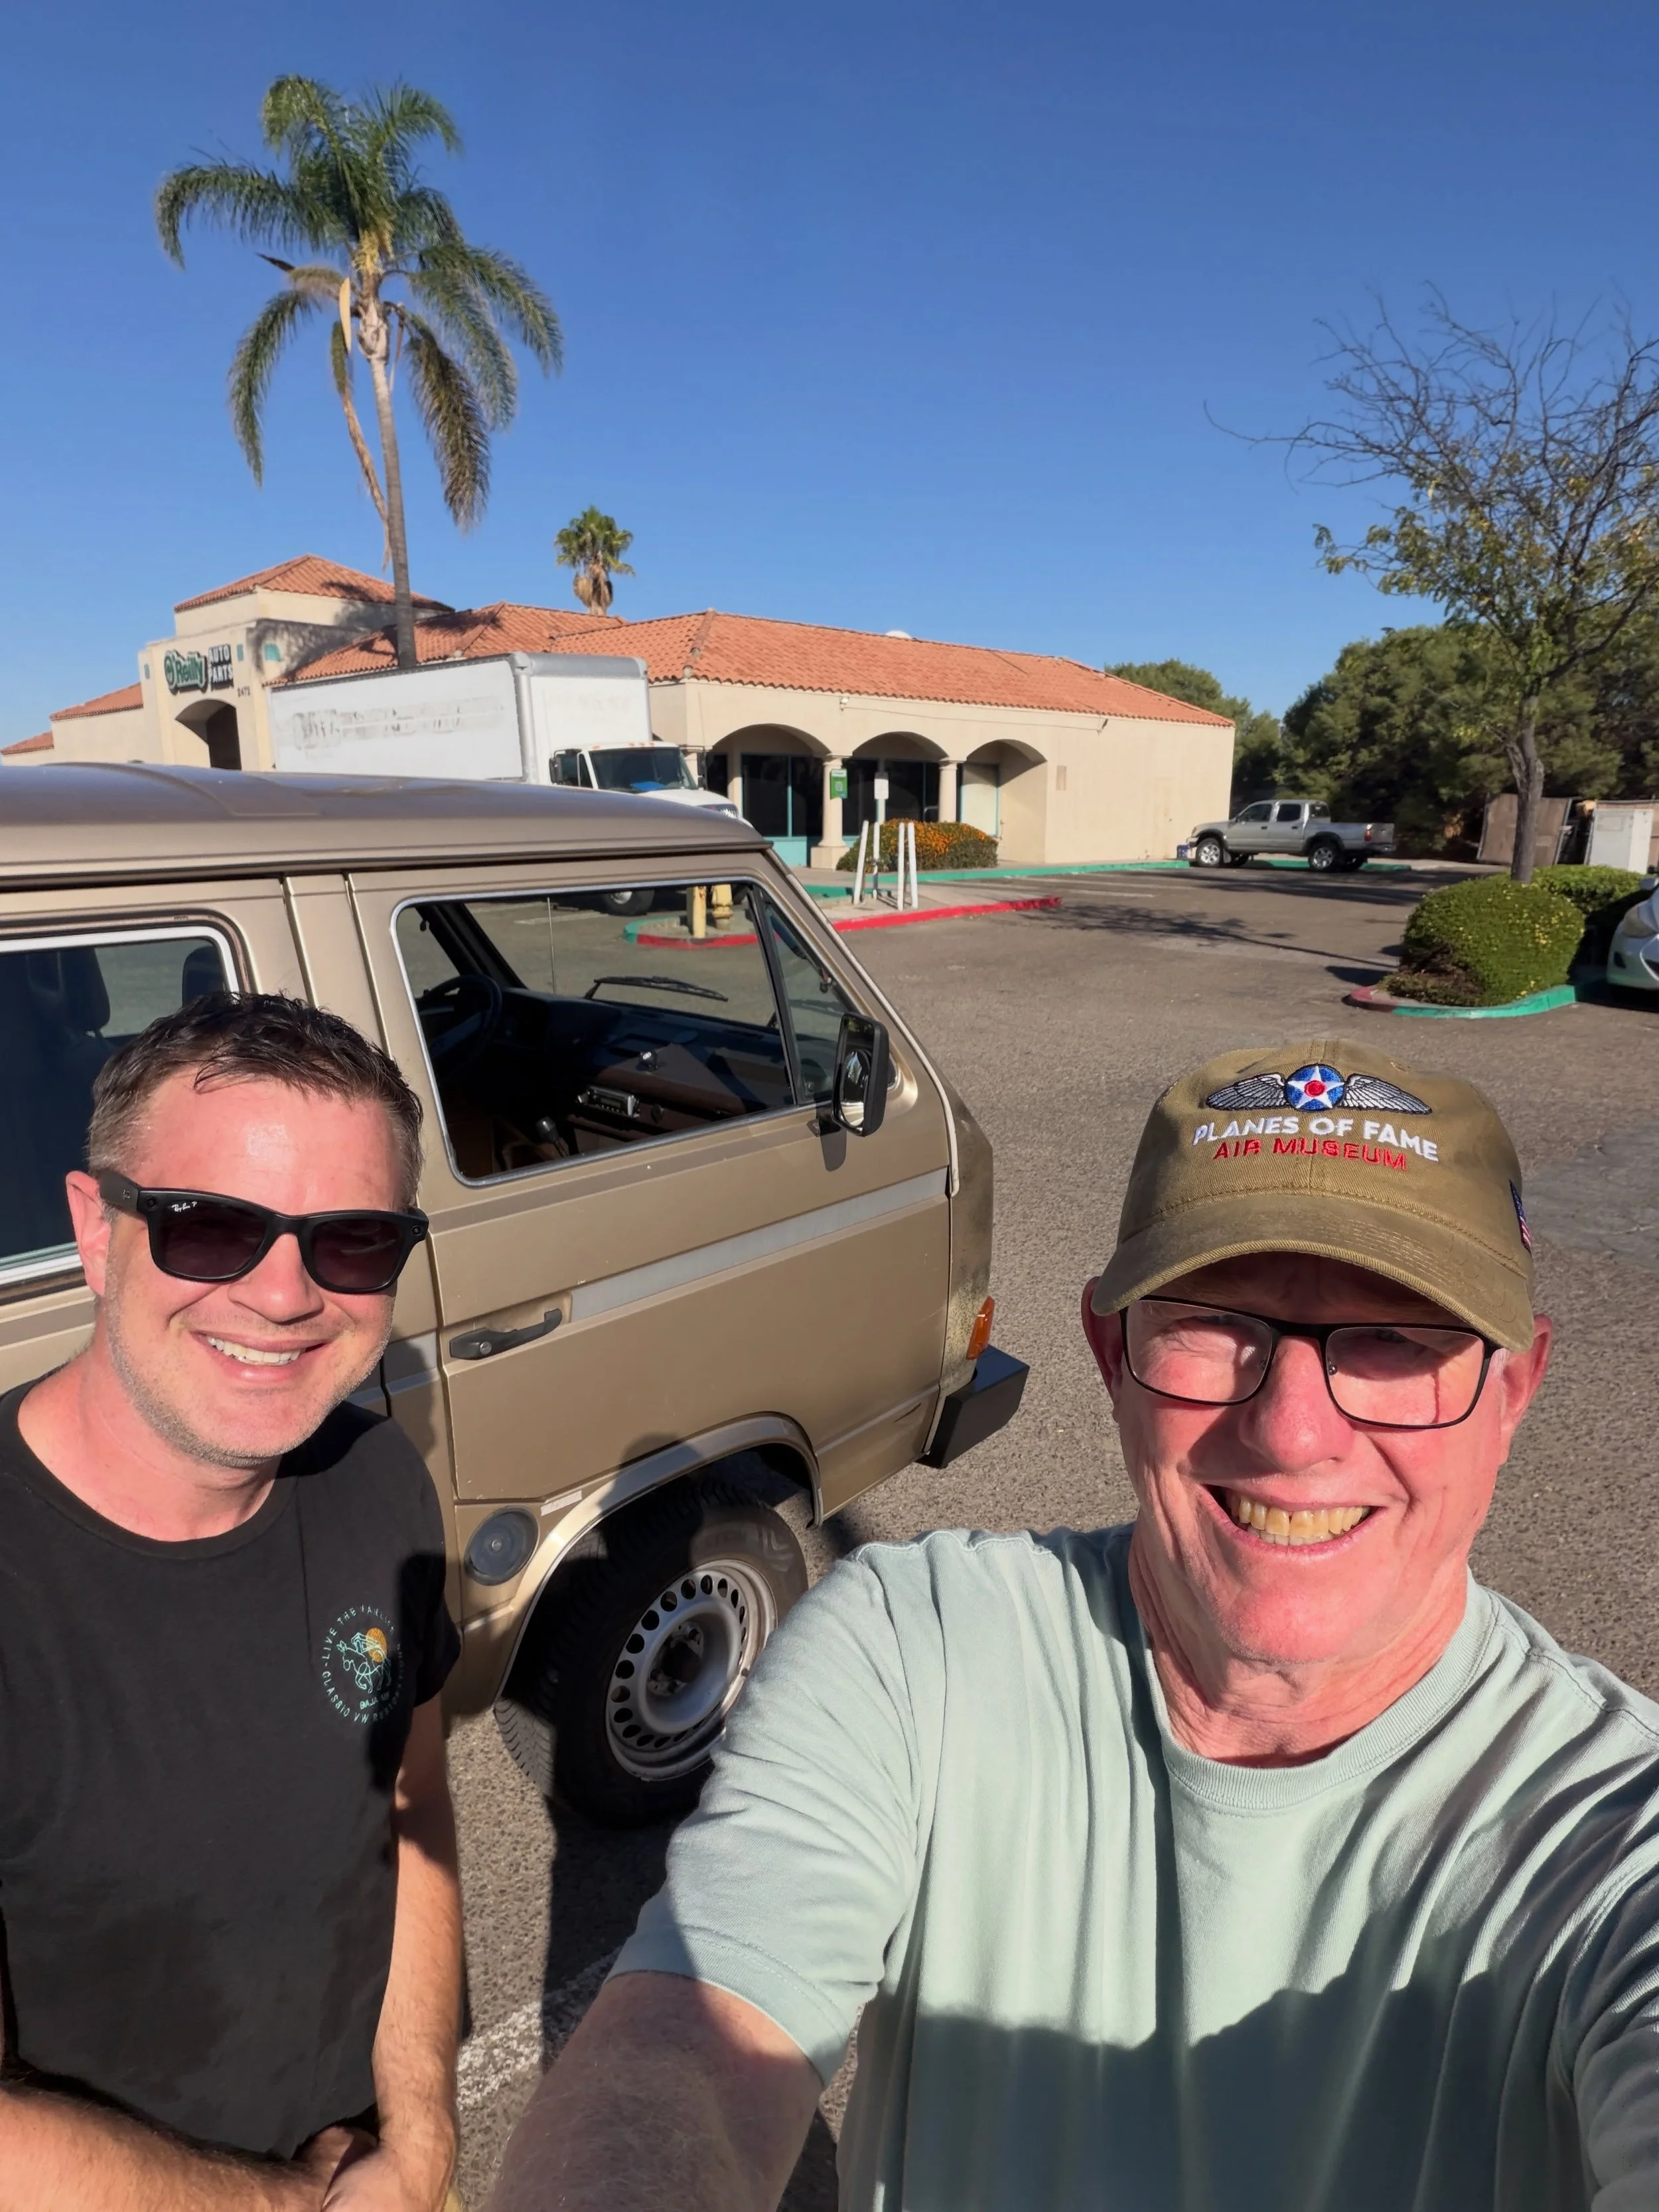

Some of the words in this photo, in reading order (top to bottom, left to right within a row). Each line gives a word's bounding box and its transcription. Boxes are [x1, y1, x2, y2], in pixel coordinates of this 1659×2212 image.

[209, 645, 230, 663] AUTO
[208, 664, 234, 684] PARTS
[1192, 1116, 1299, 1145] PLANES
[1309, 1117, 1354, 1137] OF
[1363, 1120, 1439, 1162] FAME
[1213, 1139, 1261, 1159] AIR
[1273, 1137, 1407, 1171] MUSEUM
[322, 1627, 337, 1659] LIVE
[336, 1607, 356, 1625] THE
[354, 1712, 370, 1724] VW
